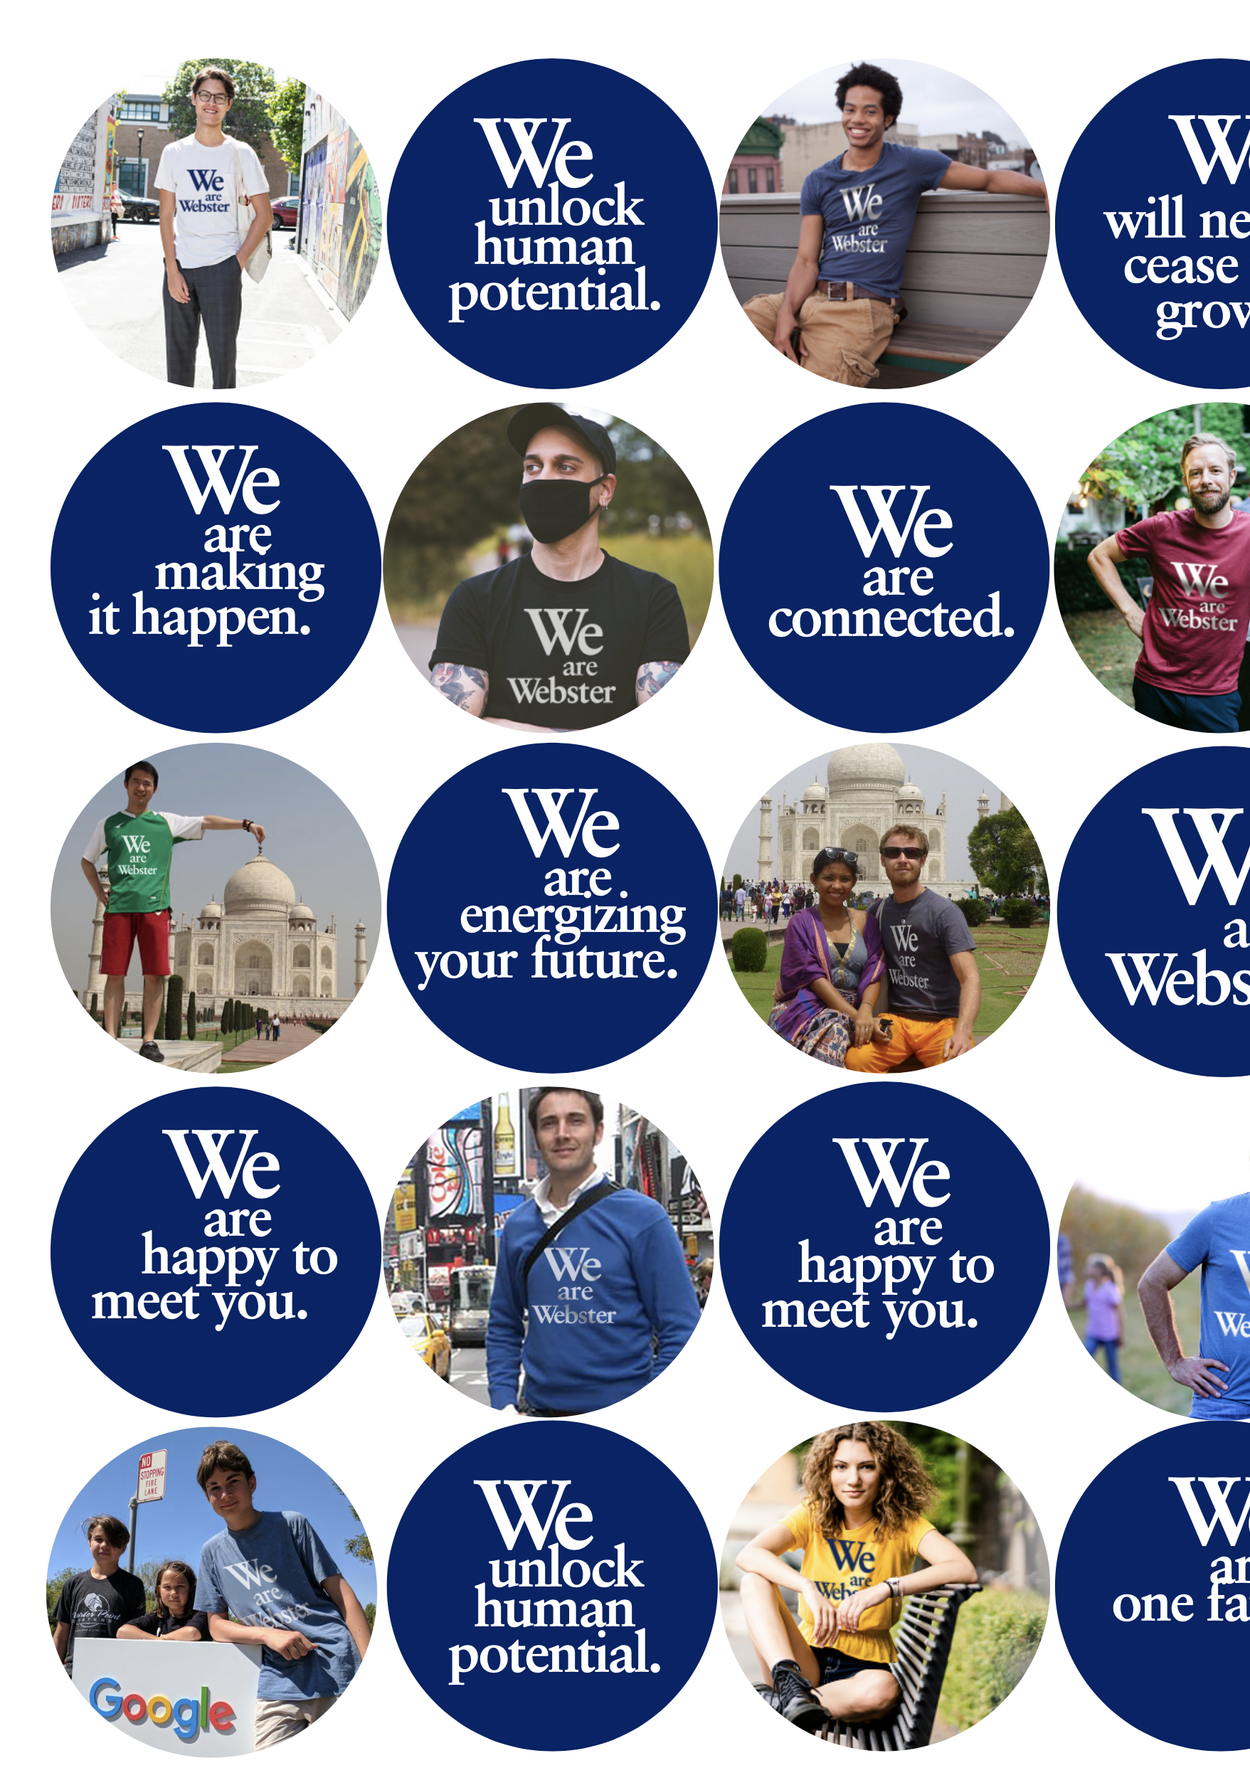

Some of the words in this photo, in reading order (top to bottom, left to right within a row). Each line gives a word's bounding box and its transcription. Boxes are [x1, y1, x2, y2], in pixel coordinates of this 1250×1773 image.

[474, 118, 593, 188] We
[186, 169, 224, 192] We
[179, 199, 230, 212] Webster
[205, 194, 222, 202] are
[489, 181, 645, 226] unlock
[840, 183, 883, 223] We
[859, 223, 878, 236] are
[1103, 194, 1186, 239] will
[475, 220, 635, 265] human
[832, 234, 888, 254] Webster
[1125, 256, 1238, 283] cease
[449, 266, 660, 323] potential.
[162, 445, 280, 514] We
[830, 485, 953, 558] We
[204, 525, 272, 553] are
[155, 547, 324, 602] making
[863, 567, 934, 596] are
[1171, 562, 1229, 598] We
[89, 593, 120, 635] it
[132, 591, 310, 647] happen.
[769, 591, 1014, 637] connected.
[1157, 608, 1238, 632] Webster
[1199, 600, 1225, 615] are
[525, 608, 603, 657] We
[563, 658, 597, 677] are
[506, 677, 616, 705] Webster
[502, 789, 620, 858] We
[121, 835, 150, 855] We
[129, 855, 147, 863] are
[118, 864, 157, 876] Webster
[544, 868, 612, 896] are
[461, 891, 686, 945] energizing
[890, 924, 919, 953] We
[415, 951, 518, 990] your
[531, 934, 677, 978] future.
[900, 954, 916, 968] are
[888, 969, 929, 990] Webster
[162, 1130, 280, 1199] We
[832, 1138, 950, 1207] We
[204, 1209, 272, 1237] are
[874, 1218, 942, 1245] are
[142, 1230, 280, 1286] happy
[292, 1242, 337, 1274] to
[543, 1247, 602, 1282] We
[798, 1239, 936, 1295] happy
[949, 1250, 994, 1283] to
[558, 1286, 593, 1300] are
[92, 1286, 199, 1319] meet
[212, 1292, 307, 1331] you.
[532, 1304, 616, 1324] Webster
[762, 1295, 870, 1328] meet
[883, 1300, 977, 1340] you.
[141, 1467, 164, 1480] STOPPING
[142, 1456, 151, 1467] NO
[145, 1487, 157, 1496] LANE
[146, 1479, 157, 1487] FIRE
[474, 1480, 593, 1550] We
[489, 1543, 645, 1587] unlock
[826, 1539, 875, 1573] We
[223, 1558, 277, 1590] We
[850, 1576, 872, 1587] are
[254, 1587, 282, 1606] are
[475, 1583, 635, 1627] human
[1113, 1594, 1194, 1622] one
[242, 1602, 313, 1628] Webster
[449, 1628, 660, 1685] potential.
[89, 1677, 235, 1739] Google
